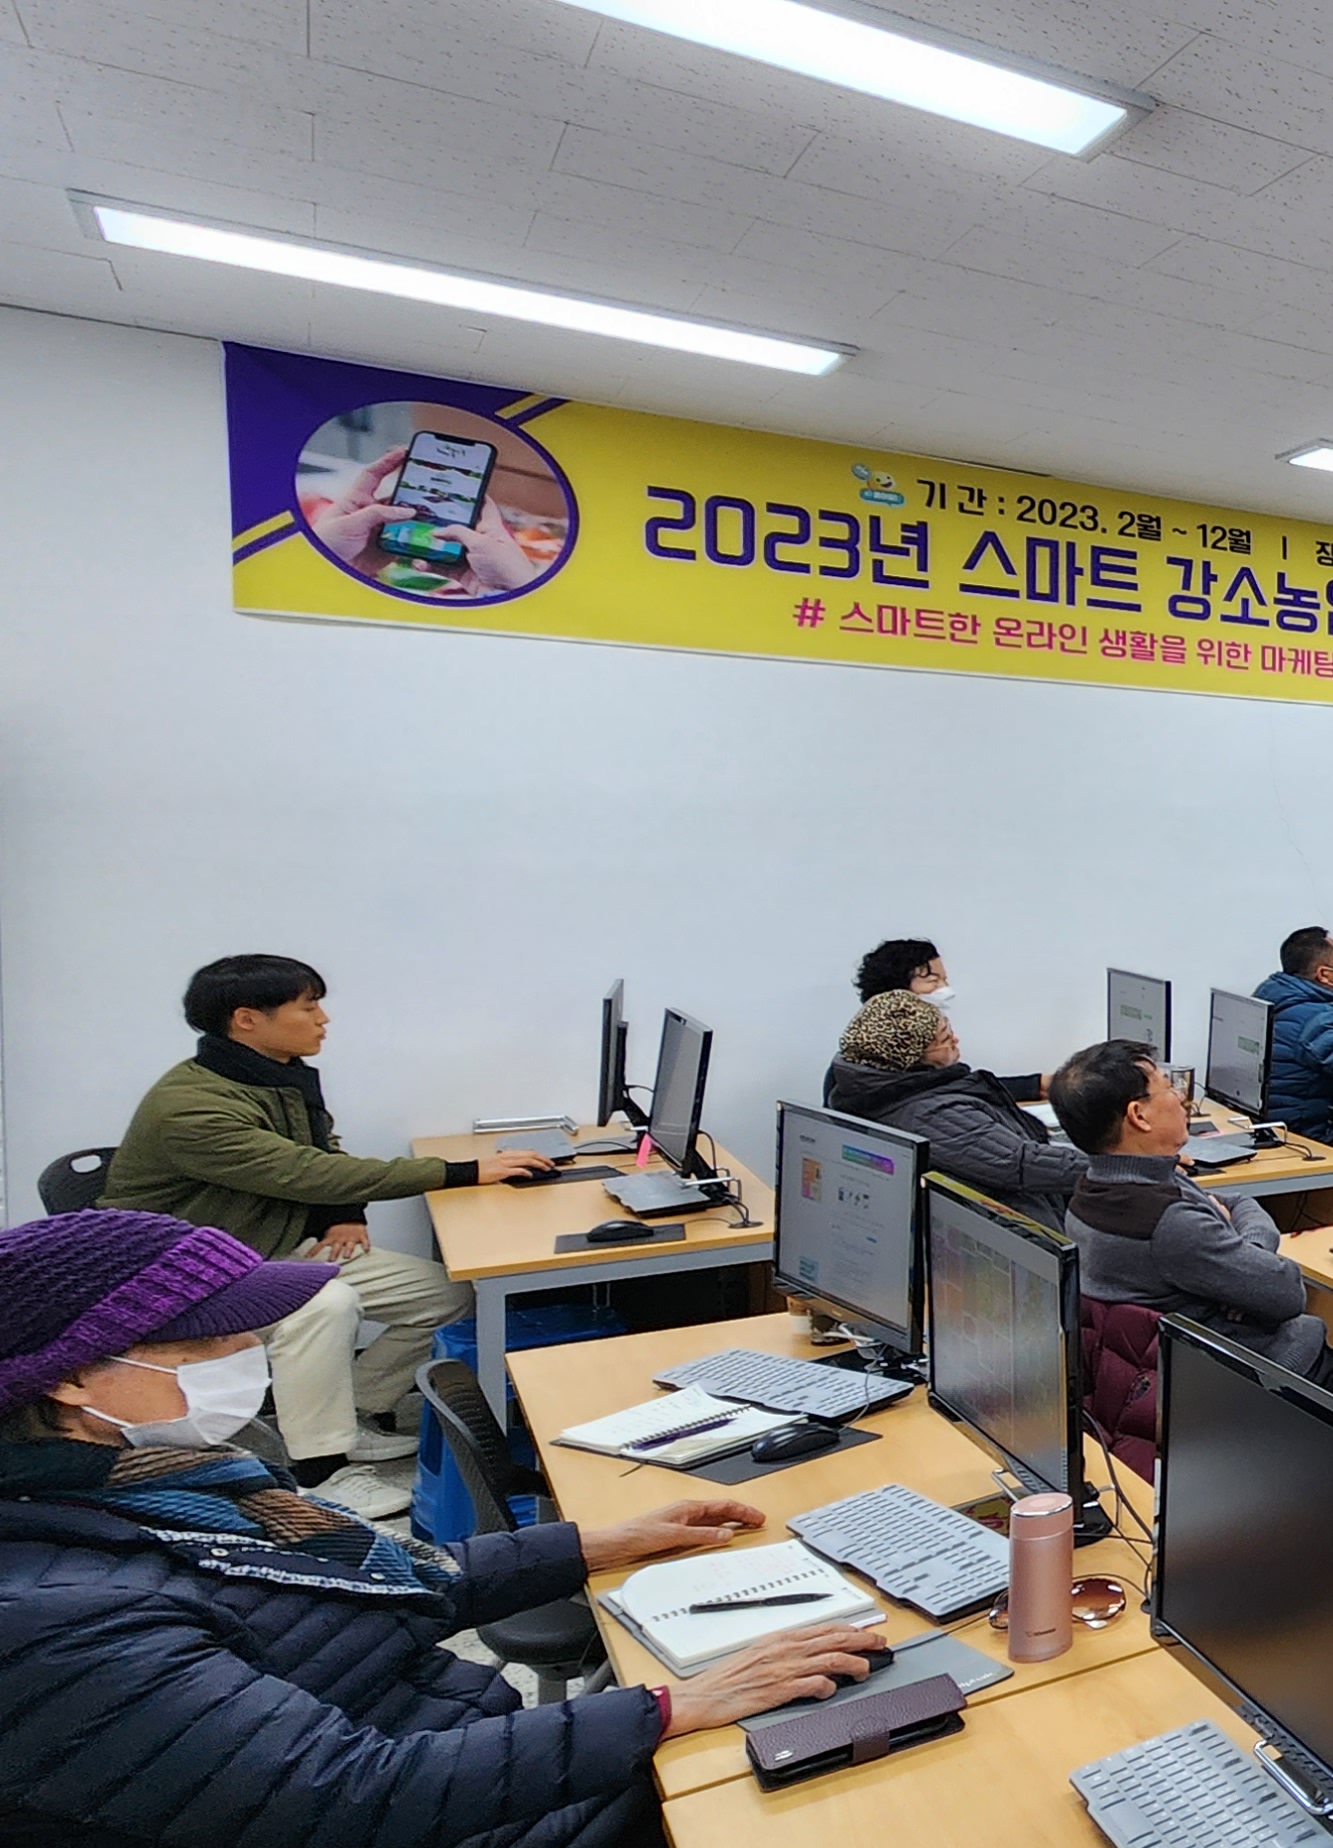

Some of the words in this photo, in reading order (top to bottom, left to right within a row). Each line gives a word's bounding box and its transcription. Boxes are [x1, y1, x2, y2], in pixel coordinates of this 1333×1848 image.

[644, 485, 931, 590] 2023년
[958, 530, 1142, 613] 스마트
[916, 478, 947, 511] 기
[956, 485, 987, 516] 간
[1016, 495, 1107, 532] 2023.
[1118, 511, 1162, 542] 2월
[1171, 524, 1188, 537] ~
[1197, 523, 1252, 556] 12월
[792, 597, 826, 628] #
[838, 601, 981, 645] 스마트한
[993, 616, 1088, 655] 온라인
[1099, 627, 1187, 665] 생활을
[1197, 638, 1251, 671] 위한
